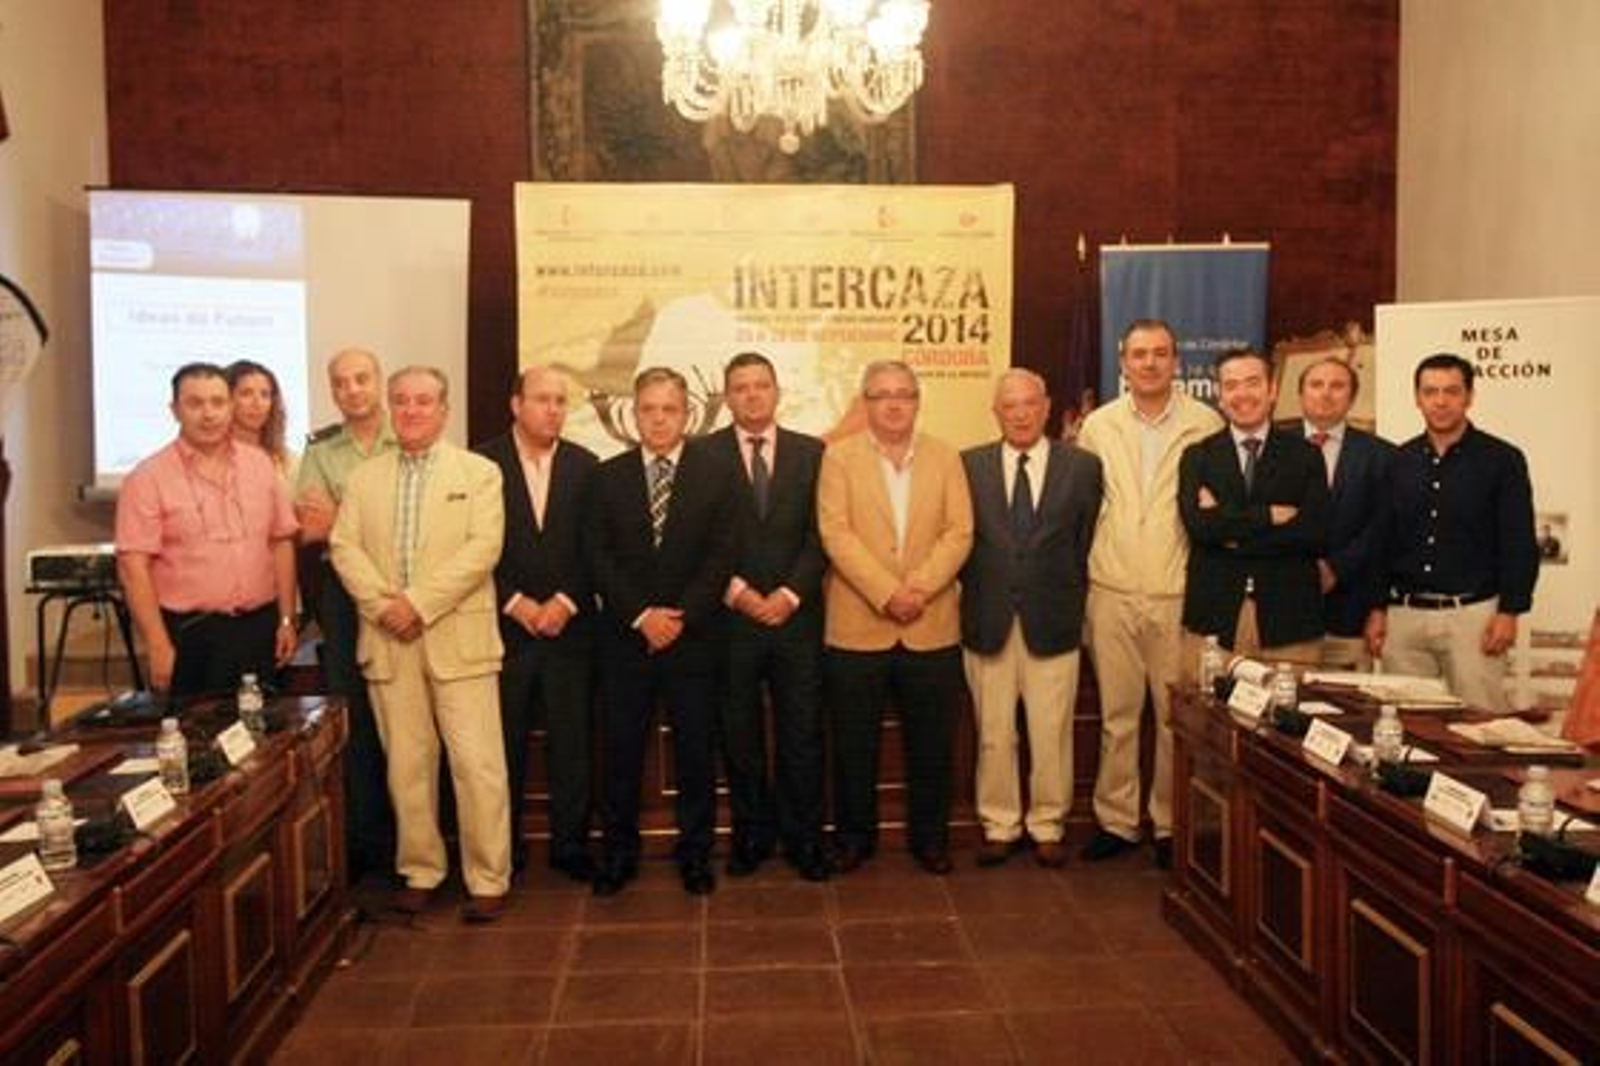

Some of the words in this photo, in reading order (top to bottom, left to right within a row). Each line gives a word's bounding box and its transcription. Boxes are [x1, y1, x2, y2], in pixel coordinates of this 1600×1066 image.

[733, 264, 990, 309] INTERCAZA
[902, 312, 990, 345] 2014
[1461, 327, 1520, 342] MESA
[1476, 346, 1502, 360] DE
[1472, 360, 1552, 378] ACCIÓN
